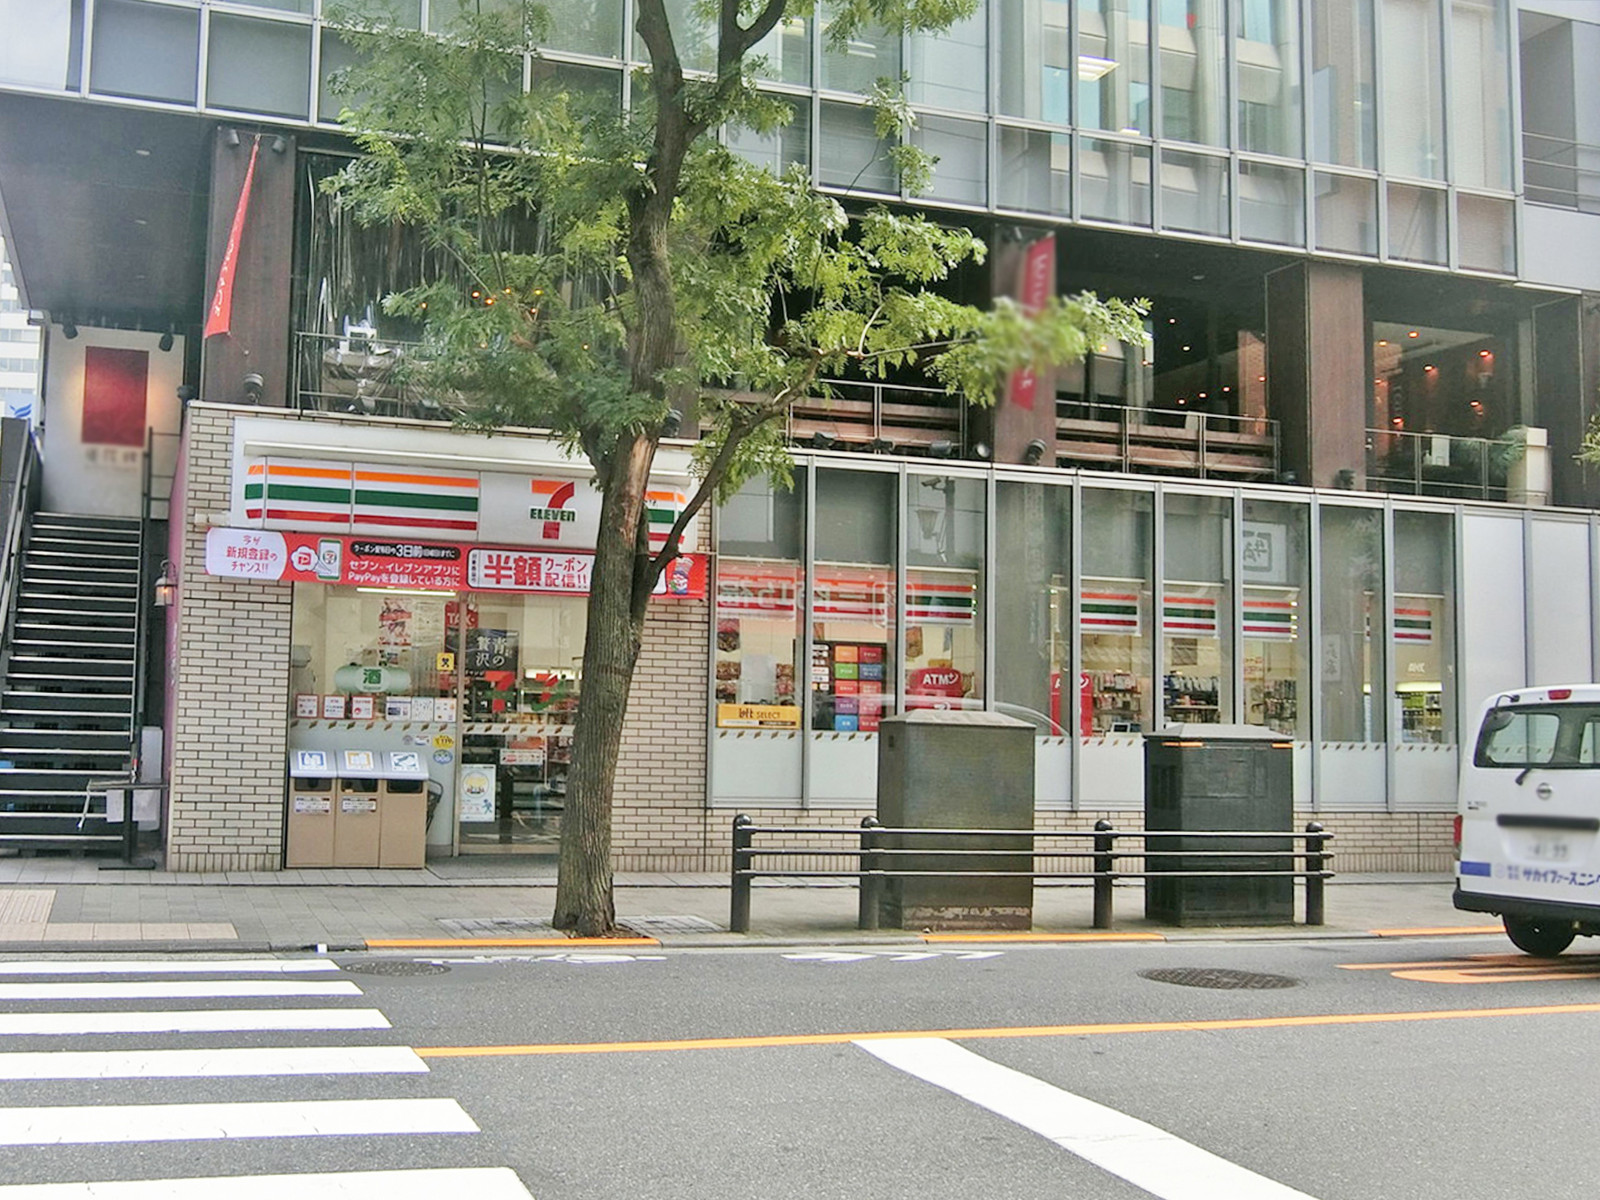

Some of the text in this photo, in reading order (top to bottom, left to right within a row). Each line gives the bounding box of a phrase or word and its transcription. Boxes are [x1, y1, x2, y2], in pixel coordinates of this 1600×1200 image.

[226, 546, 278, 561] 新規登録の
[484, 554, 542, 586] 半額
[545, 557, 587, 573] クーポン
[348, 571, 460, 587] PayPayを登録している方に
[545, 572, 587, 589] 配信!!
[363, 668, 382, 684] 酒
[922, 673, 949, 685] ATM
[756, 711, 781, 719] SELECT
[1523, 868, 1600, 886] サカイファースニン
